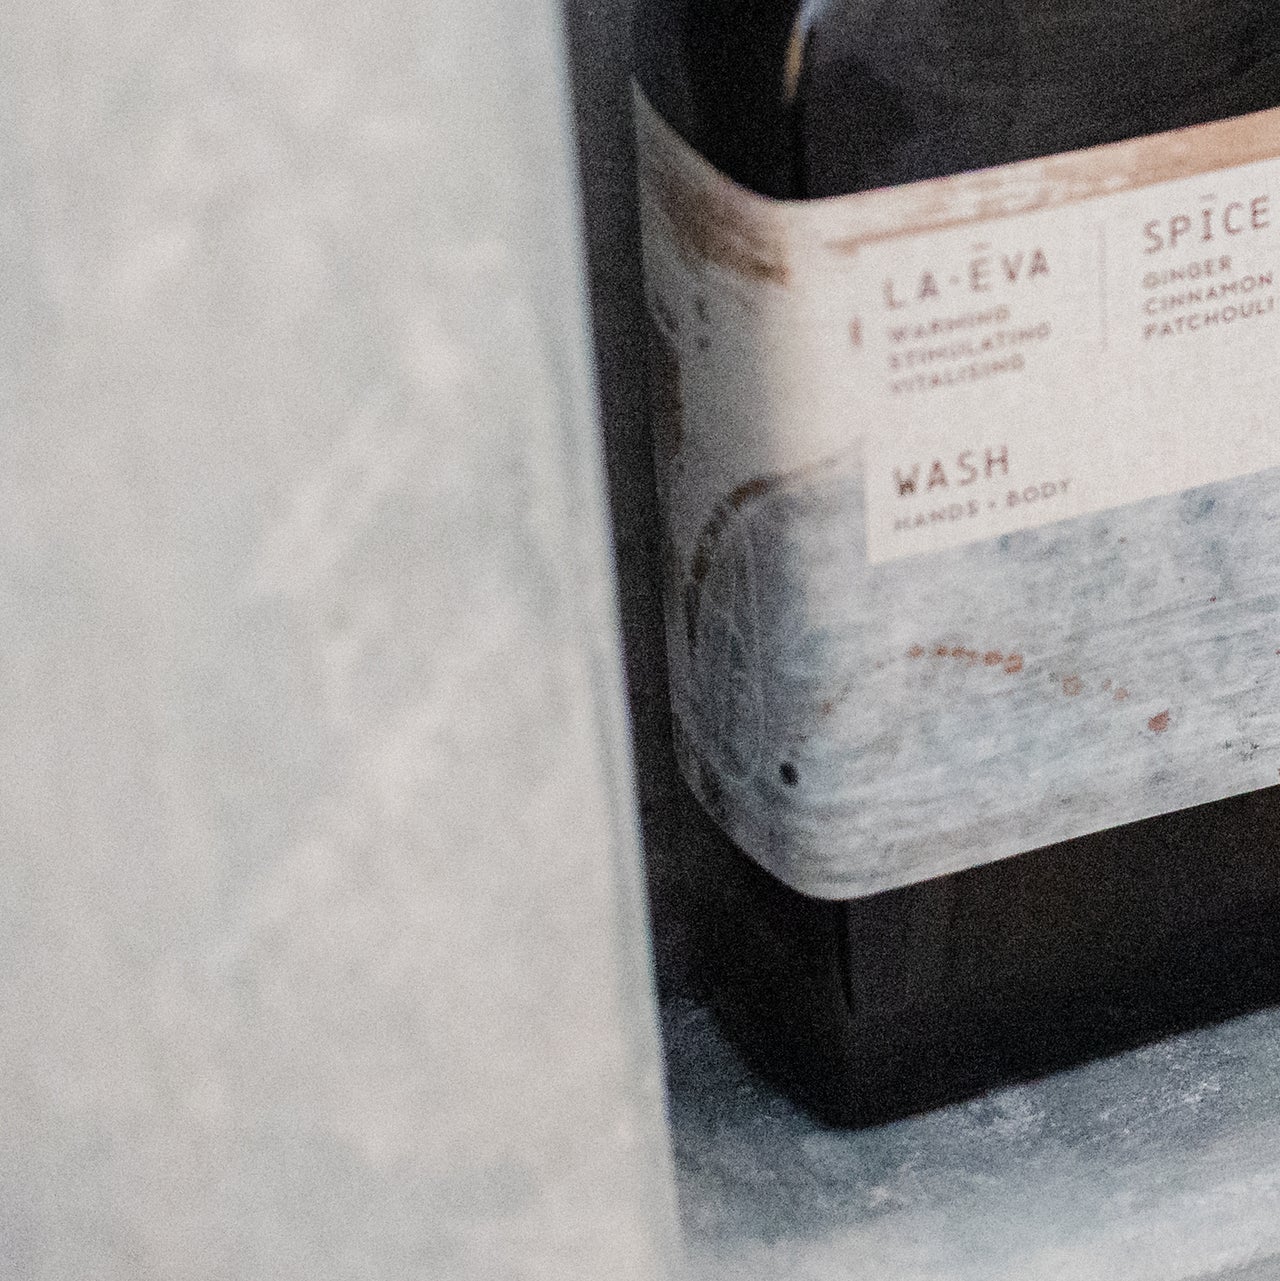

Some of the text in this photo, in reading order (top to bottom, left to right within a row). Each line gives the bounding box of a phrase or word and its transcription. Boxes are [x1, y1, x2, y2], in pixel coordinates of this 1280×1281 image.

[1142, 255, 1233, 289] GINGER
[1142, 271, 1273, 316] CINNAMON
[1143, 295, 1275, 340] PATCHOULI
[888, 322, 1051, 370] STIMULATING
[894, 445, 1009, 497] WASH
[894, 477, 1072, 531] HANDS BODY
